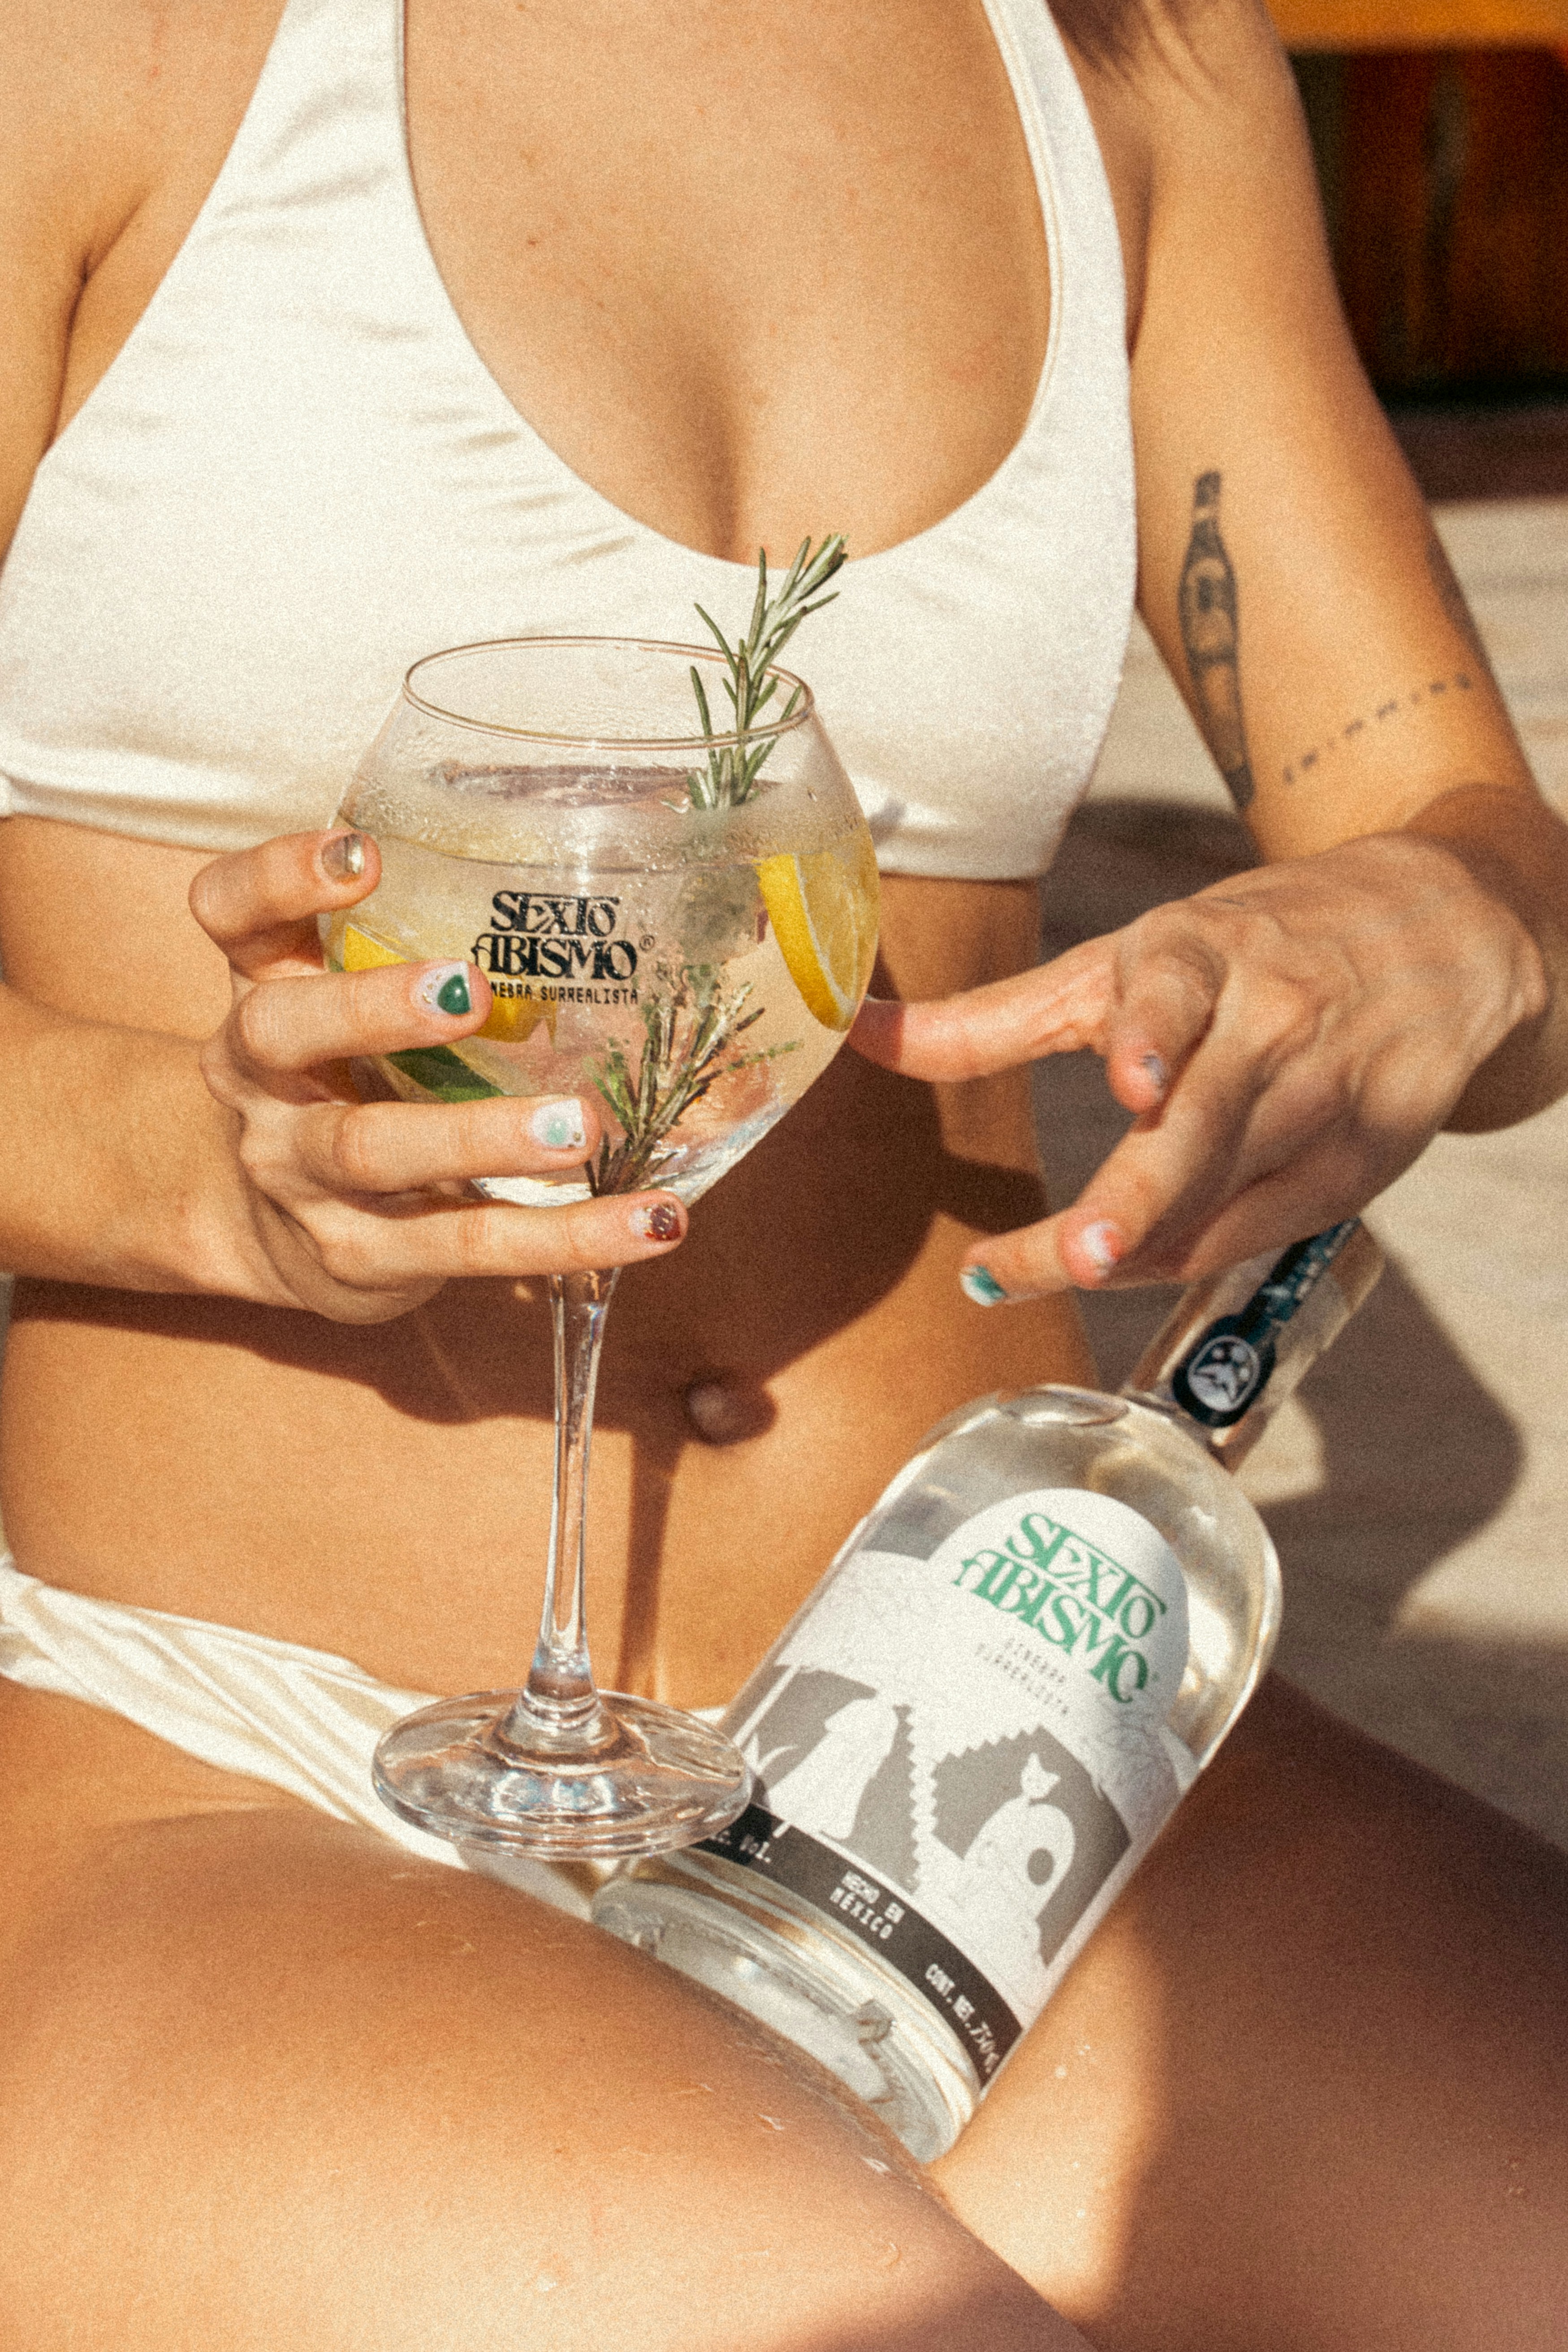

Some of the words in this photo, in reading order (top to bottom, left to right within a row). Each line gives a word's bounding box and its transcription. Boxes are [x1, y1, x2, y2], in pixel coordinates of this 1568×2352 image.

[491, 890, 620, 937] SEXTO
[491, 981, 532, 1001] NEBRA
[540, 986, 639, 1005] SURREALISTA
[1005, 1512, 1167, 1639] SEXTO
